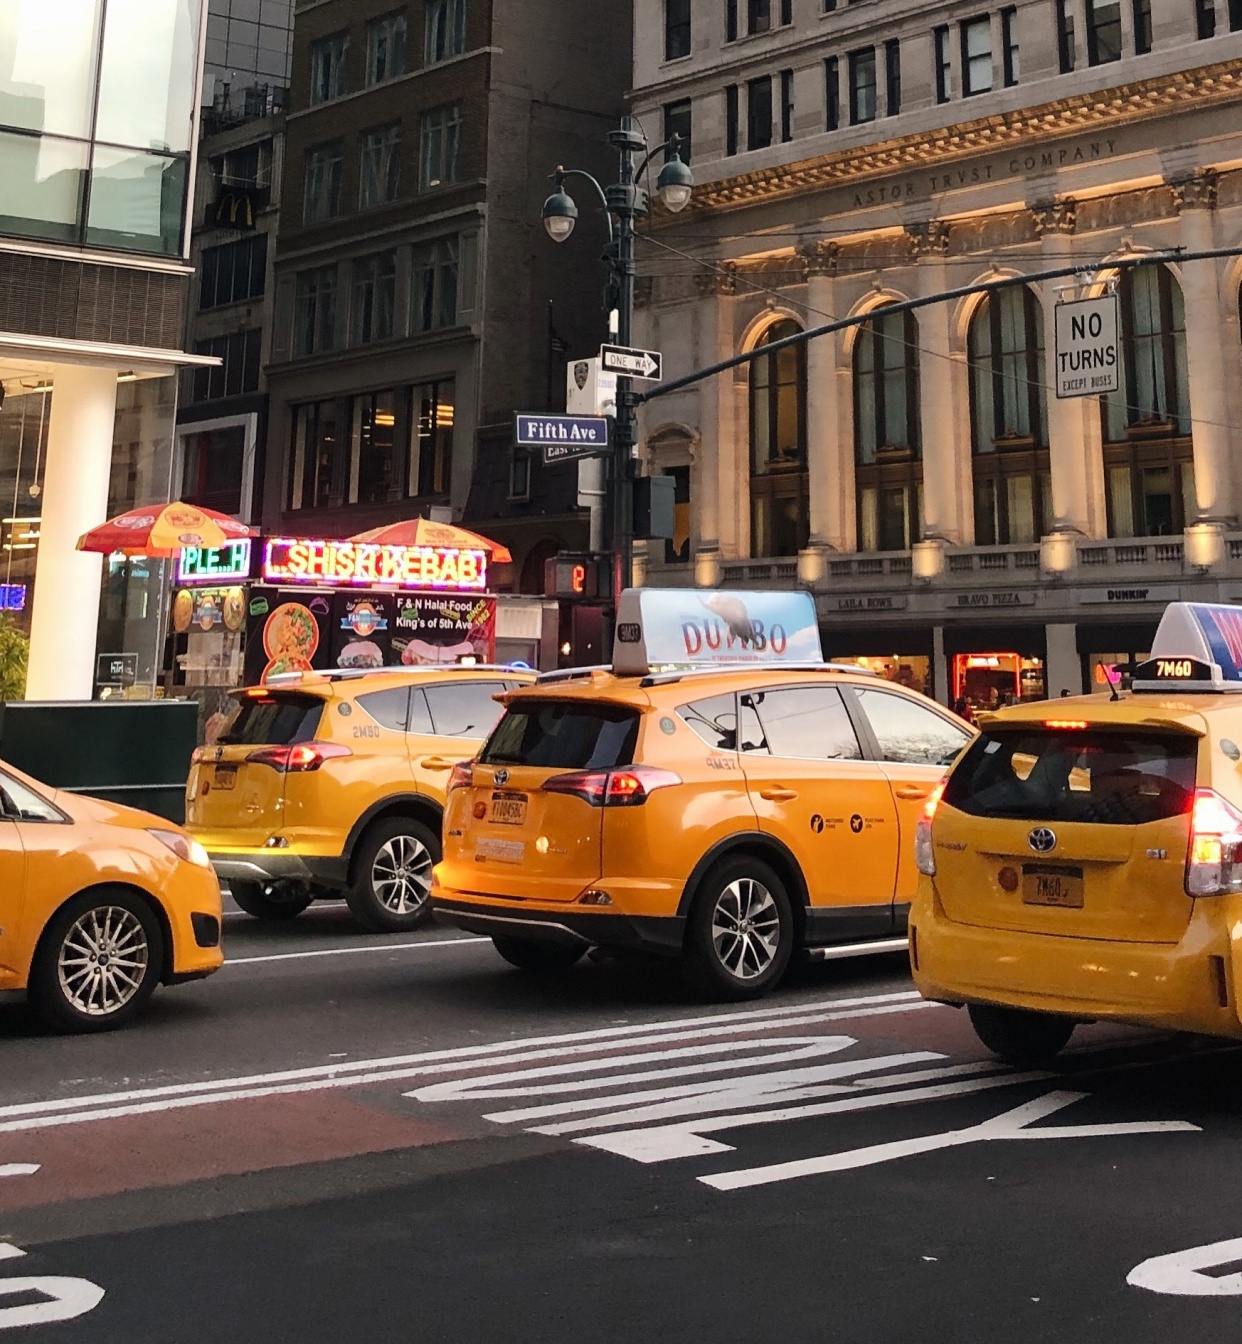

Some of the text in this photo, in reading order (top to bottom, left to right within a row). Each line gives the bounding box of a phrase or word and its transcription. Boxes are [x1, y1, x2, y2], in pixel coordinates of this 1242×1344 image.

[853, 183, 915, 206] ASTOR
[1009, 139, 1117, 174] COMPANY
[1071, 312, 1102, 341] NO
[610, 354, 653, 370] ONE WAY
[1058, 345, 1116, 373] TURNS
[1062, 374, 1112, 392] EXCEPT BUSES
[527, 421, 597, 440] Fifth Ave
[380, 545, 480, 582] KEBAB
[396, 597, 404, 609] F
[405, 597, 413, 609] &
[415, 598, 423, 609] N
[424, 598, 447, 610] Halal
[449, 599, 473, 611] Food
[957, 592, 1021, 606] BRAVO PIZZA
[1107, 589, 1149, 601] DUNKIN'
[466, 598, 487, 623] SINCE
[395, 616, 426, 631] King's
[427, 617, 439, 629] of
[439, 617, 454, 630] 5th
[455, 619, 473, 630] Ave
[1156, 660, 1192, 677] 7M60
[1036, 875, 1061, 897] 7M60
